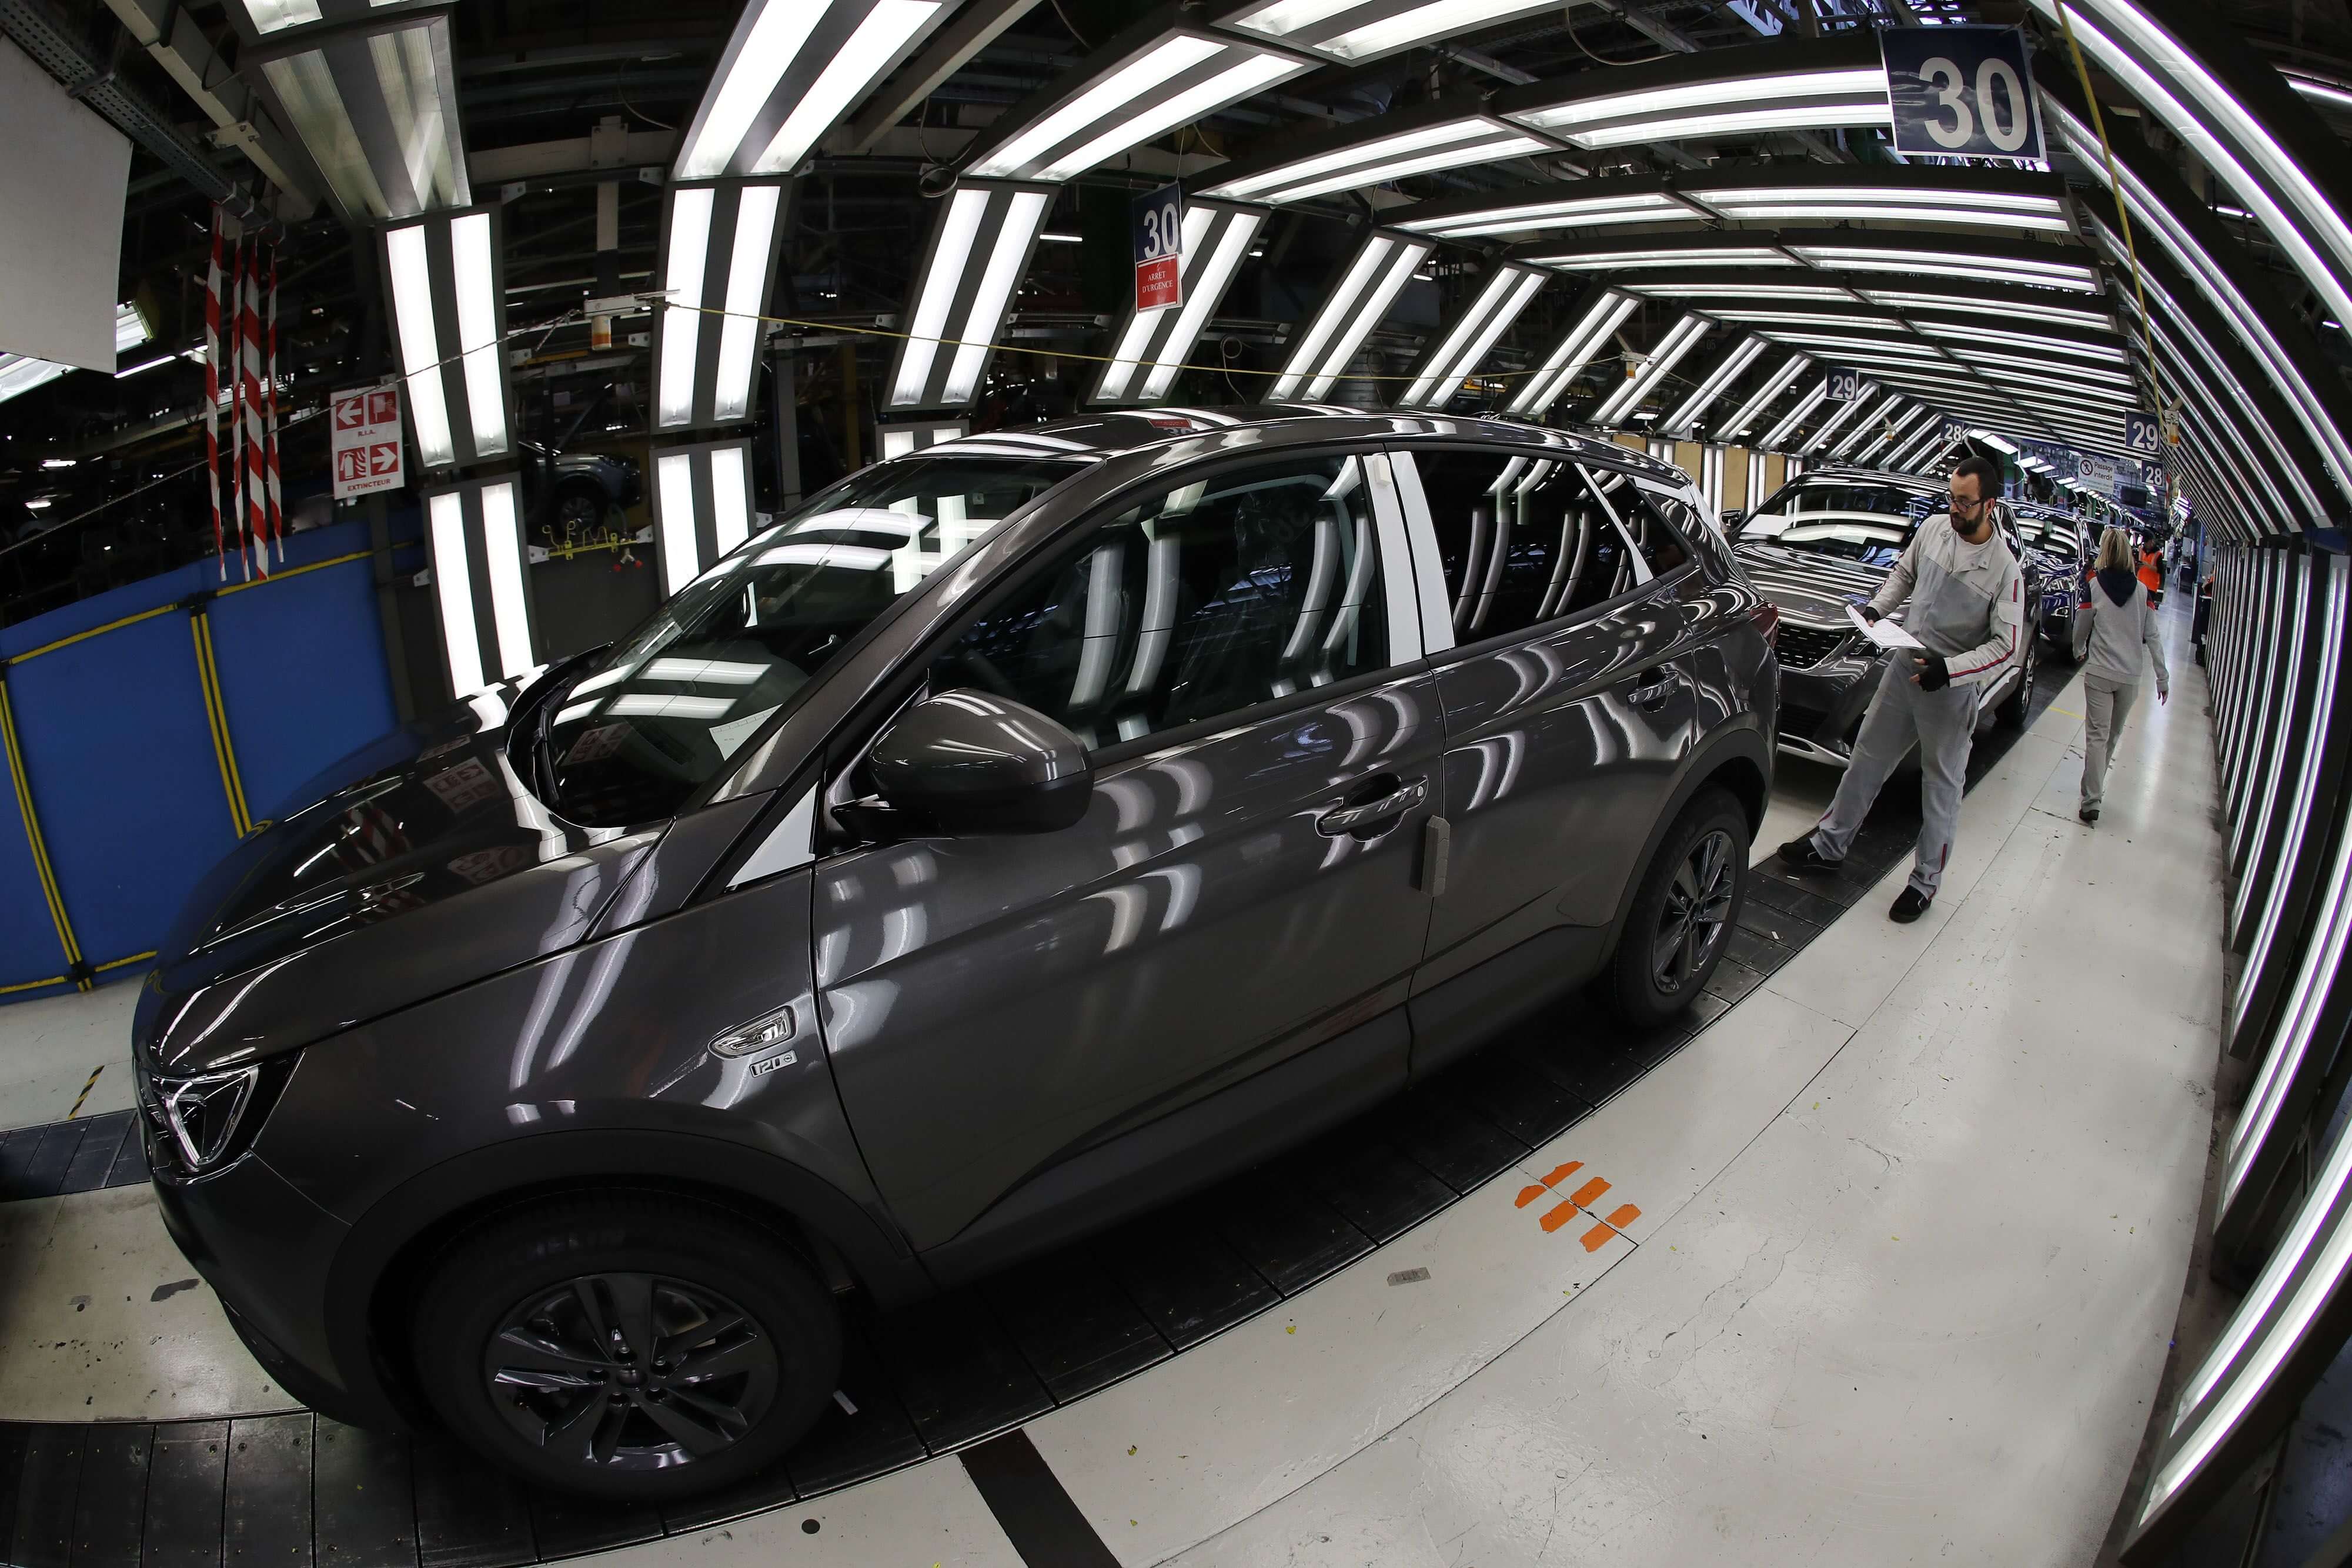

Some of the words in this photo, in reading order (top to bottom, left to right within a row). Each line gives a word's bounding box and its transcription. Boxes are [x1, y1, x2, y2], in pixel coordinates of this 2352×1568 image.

[1919, 57, 2027, 152] 30
[1144, 203, 1179, 259] 30
[1148, 270, 1166, 282] ARRET
[1142, 280, 1173, 293] D'URGENCE
[1832, 375, 1856, 400] 29
[1945, 423, 1962, 442] 28
[2132, 421, 2159, 451] 29
[2094, 462, 2113, 473] Passage
[2146, 466, 2163, 486] 28
[348, 479, 391, 492] EXTINCTEUR
